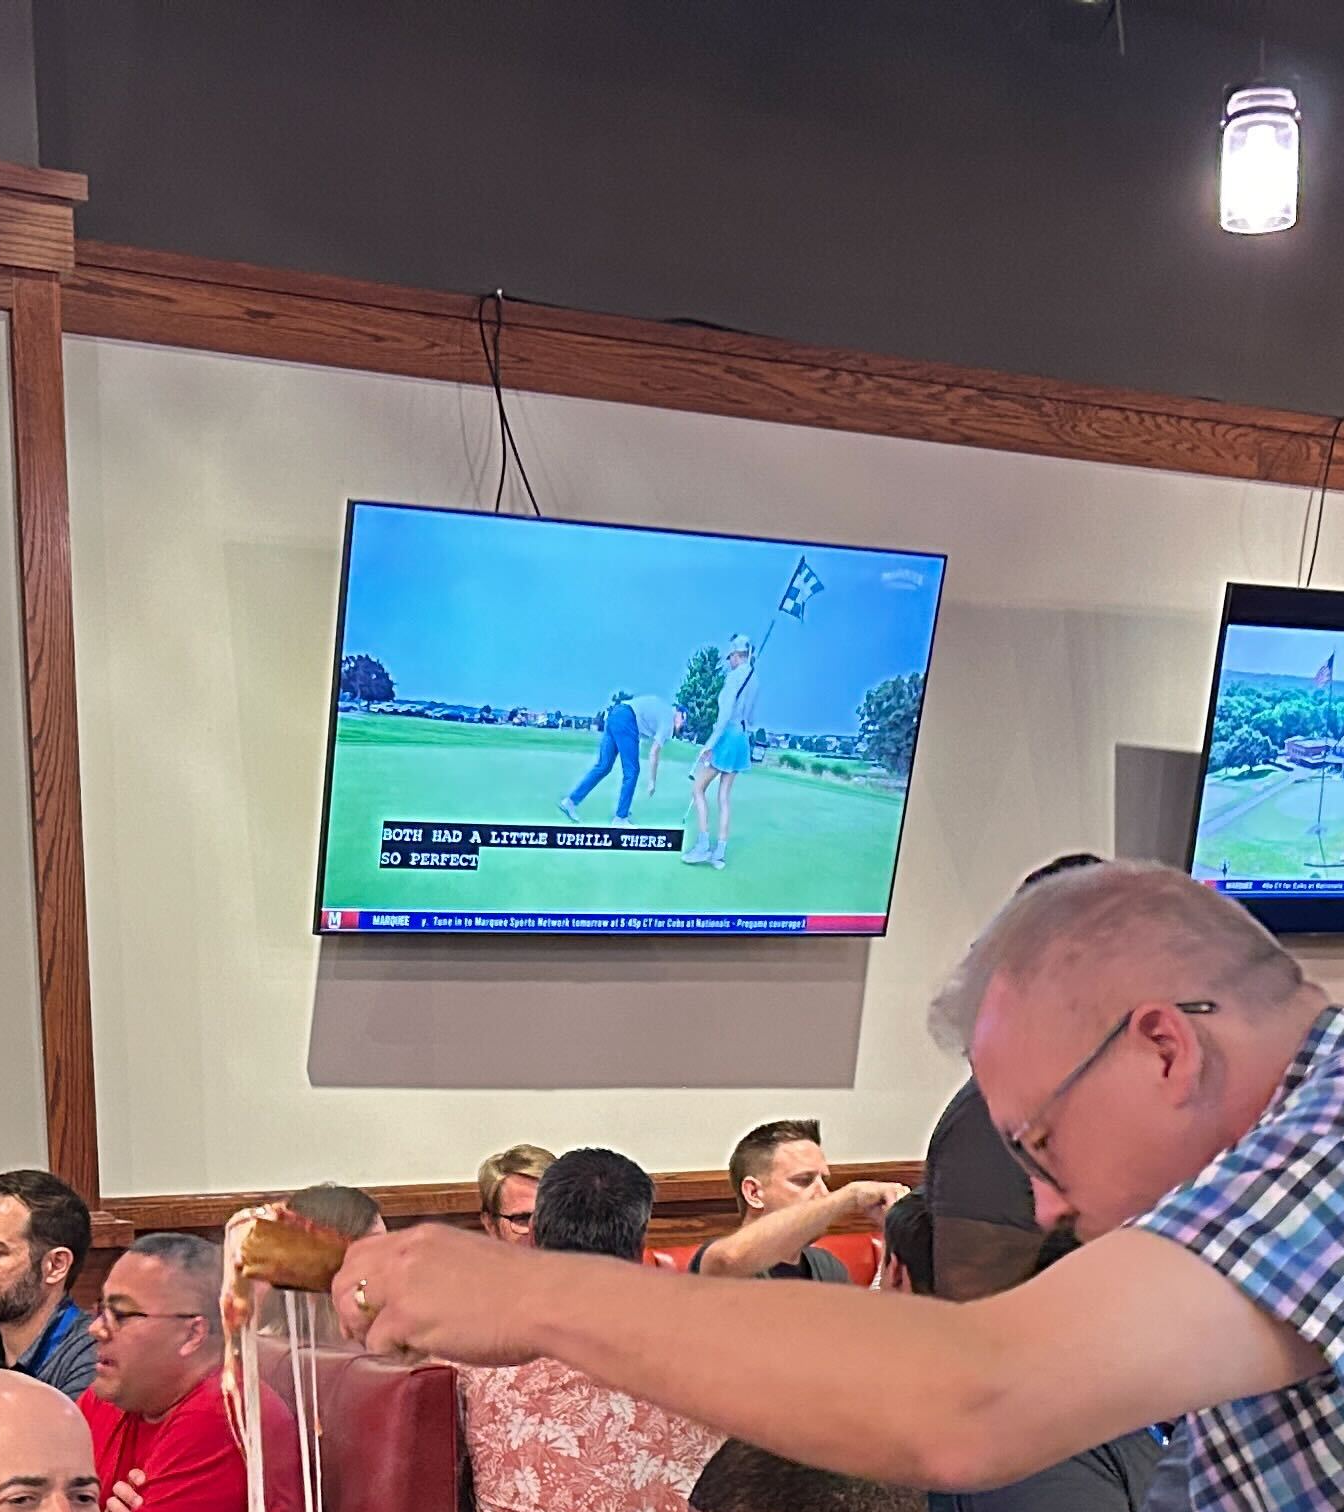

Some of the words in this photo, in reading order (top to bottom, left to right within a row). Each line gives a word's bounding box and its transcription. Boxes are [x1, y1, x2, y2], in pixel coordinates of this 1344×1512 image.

[382, 828, 423, 842] BOTH
[432, 830, 462, 843] HAD
[468, 831, 481, 844] A
[490, 831, 547, 845] LITTLE
[556, 833, 612, 847] UPHILL
[620, 835, 674, 848] THERE.
[380, 852, 402, 866] SO
[409, 853, 479, 867] PERFECT
[372, 915, 410, 927] MARQUEE
